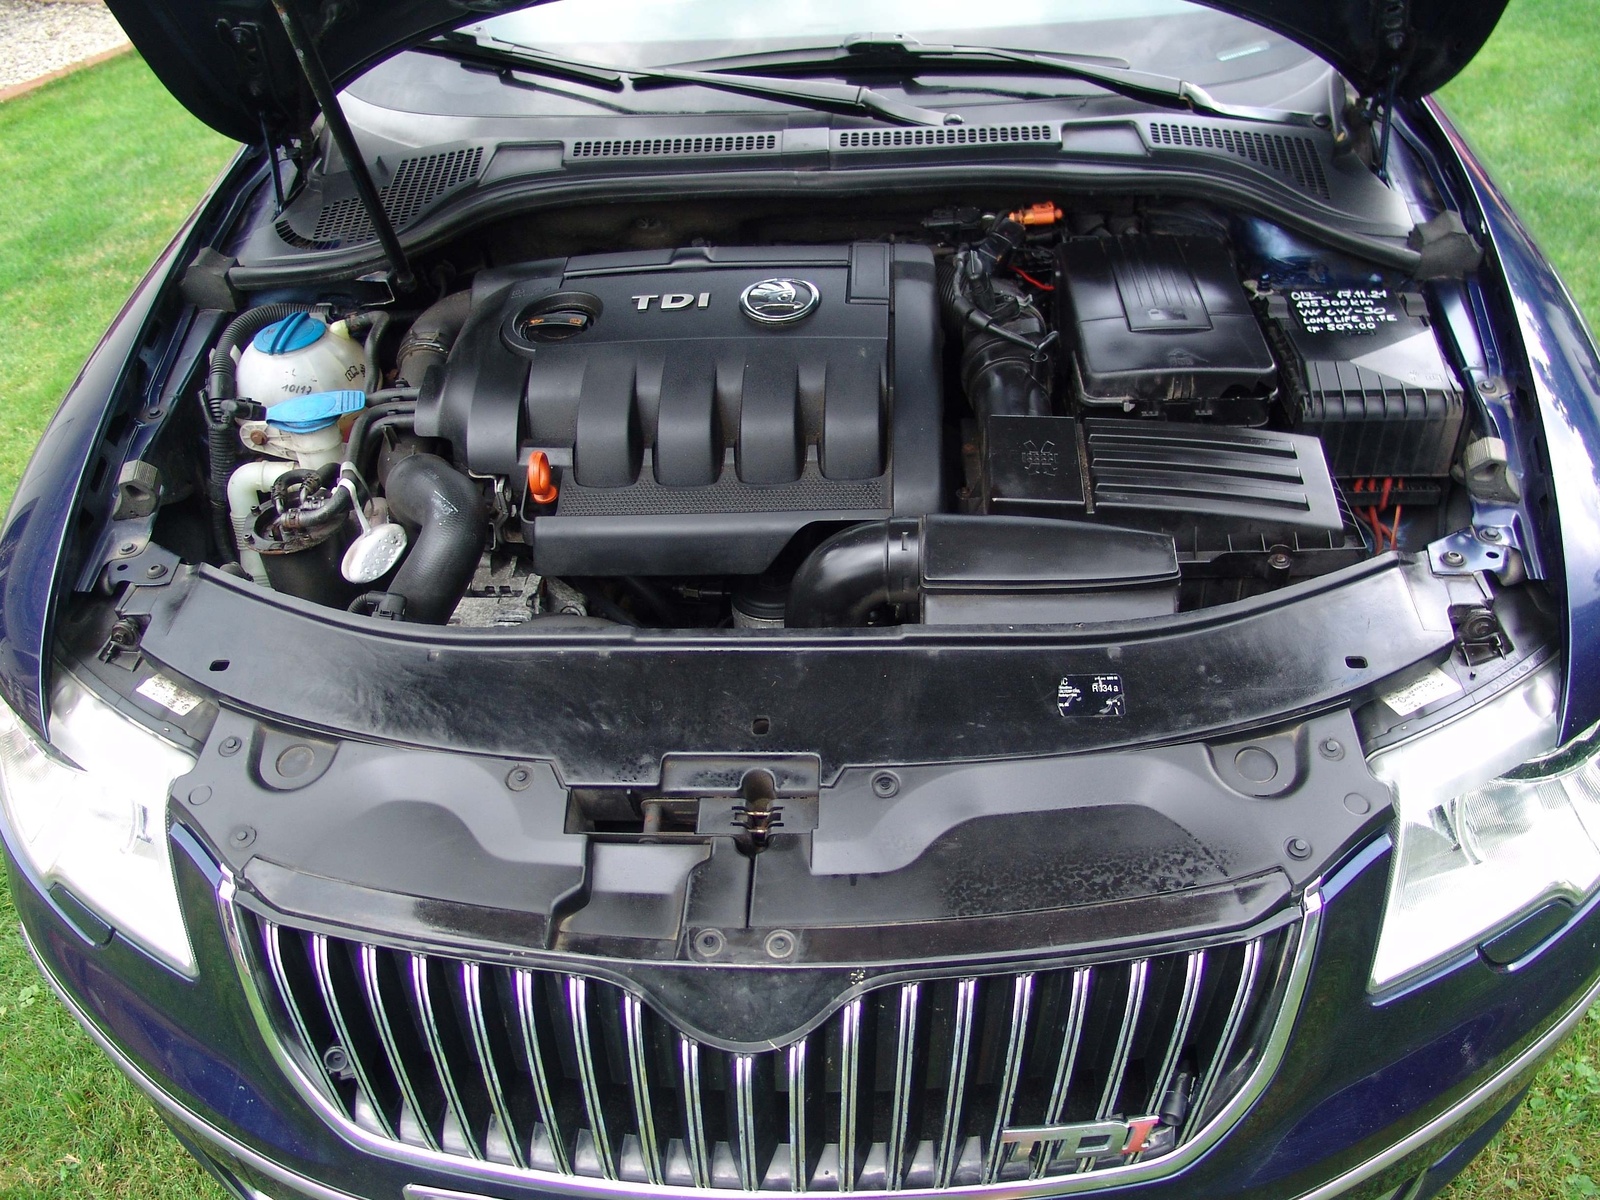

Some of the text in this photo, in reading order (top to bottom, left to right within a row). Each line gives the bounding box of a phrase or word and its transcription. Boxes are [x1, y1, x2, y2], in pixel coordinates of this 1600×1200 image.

[631, 292, 710, 312] TDI
[1299, 308, 1321, 317] VW
[1303, 317, 1332, 325] LONG
[1333, 315, 1361, 323] LIFE
[1002, 1115, 1159, 1161] TDI
